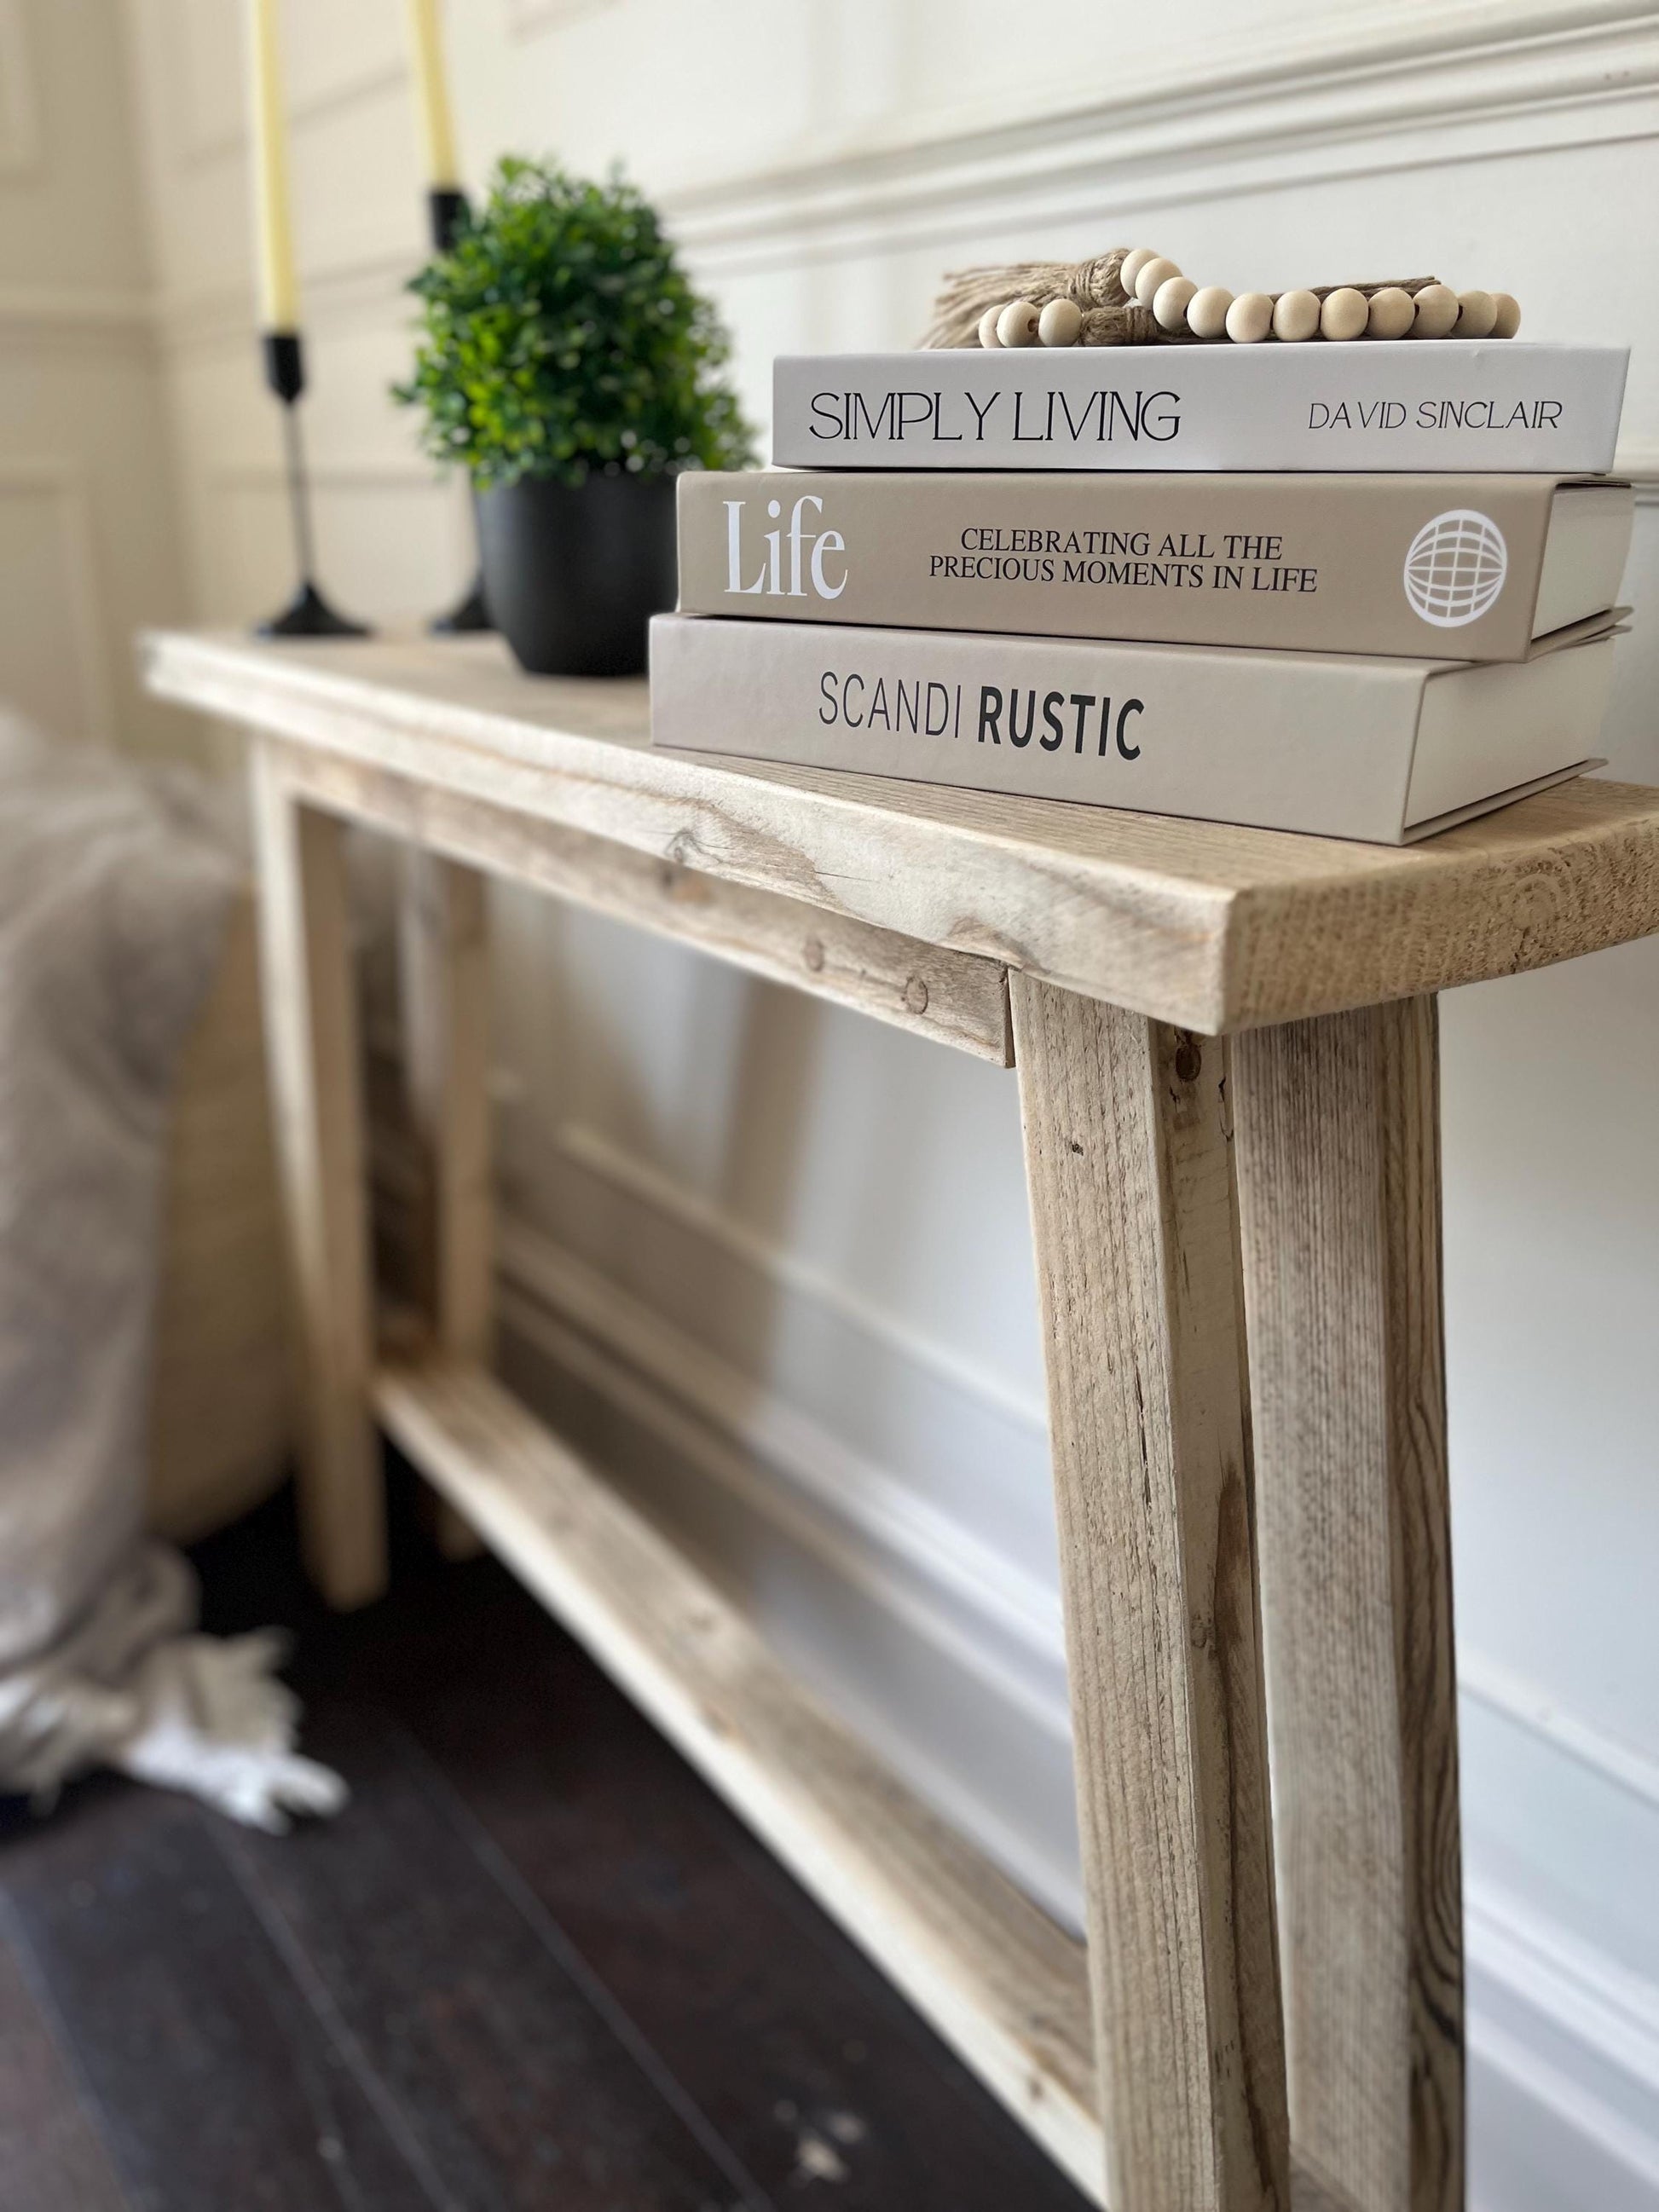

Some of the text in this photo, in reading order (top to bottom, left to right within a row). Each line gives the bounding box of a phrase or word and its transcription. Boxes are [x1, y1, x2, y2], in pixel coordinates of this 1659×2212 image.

[808, 390, 1182, 442] SIMPLY LIVING
[1308, 401, 1563, 430] DAVID SINCLAIR
[722, 495, 848, 600] Life
[961, 528, 1283, 561] CELEBRATING ALL THE
[928, 555, 1318, 593] PRECIOUS MOMENTS IN LIFE
[818, 671, 1145, 761] SCANDI RUSTIC
